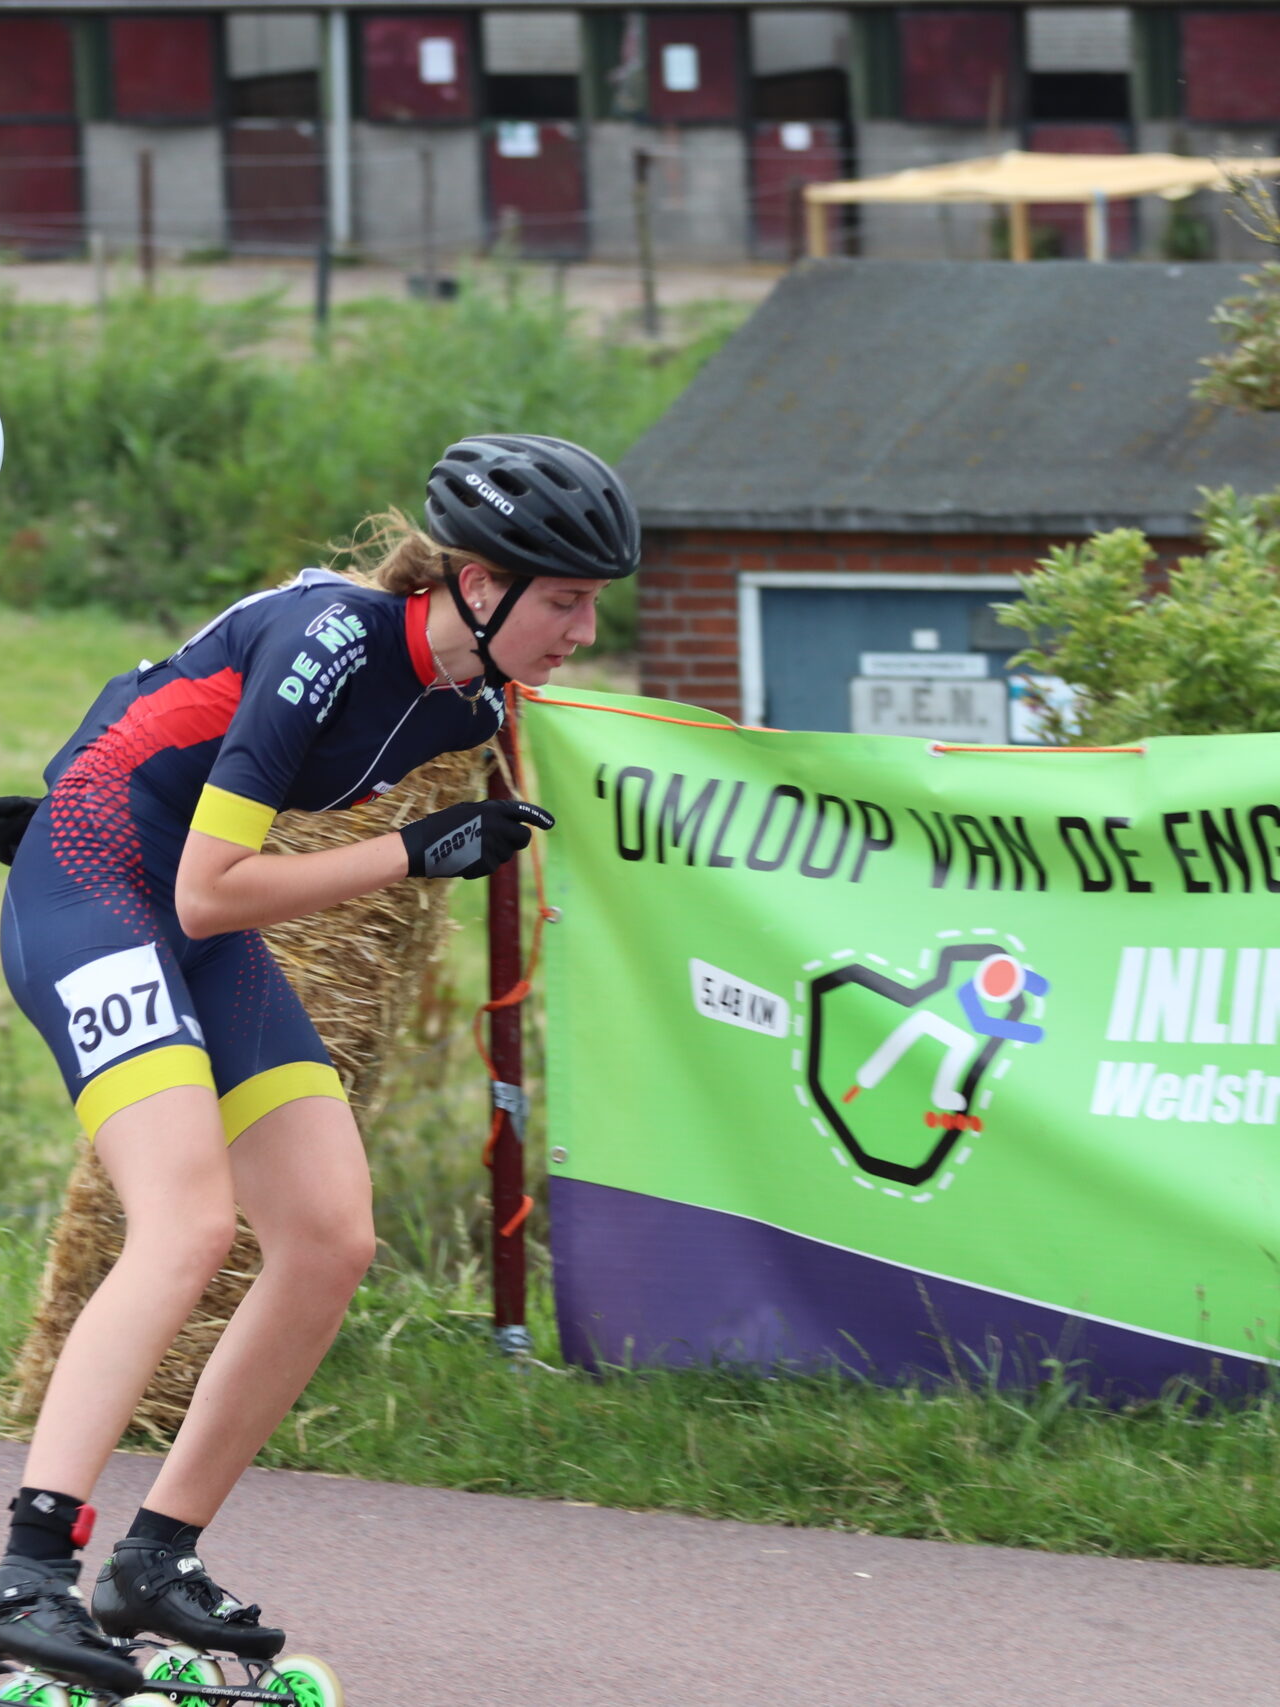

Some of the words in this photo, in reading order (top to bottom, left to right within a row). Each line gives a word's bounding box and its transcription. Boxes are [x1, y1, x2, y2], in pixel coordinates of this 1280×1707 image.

[477, 482, 515, 516] GIRO
[277, 651, 321, 705] DE
[430, 820, 482, 866] 100%
[904, 807, 1048, 892] VAN
[1056, 816, 1153, 893] DE
[72, 980, 160, 1053] 307
[747, 992, 777, 1030] KM
